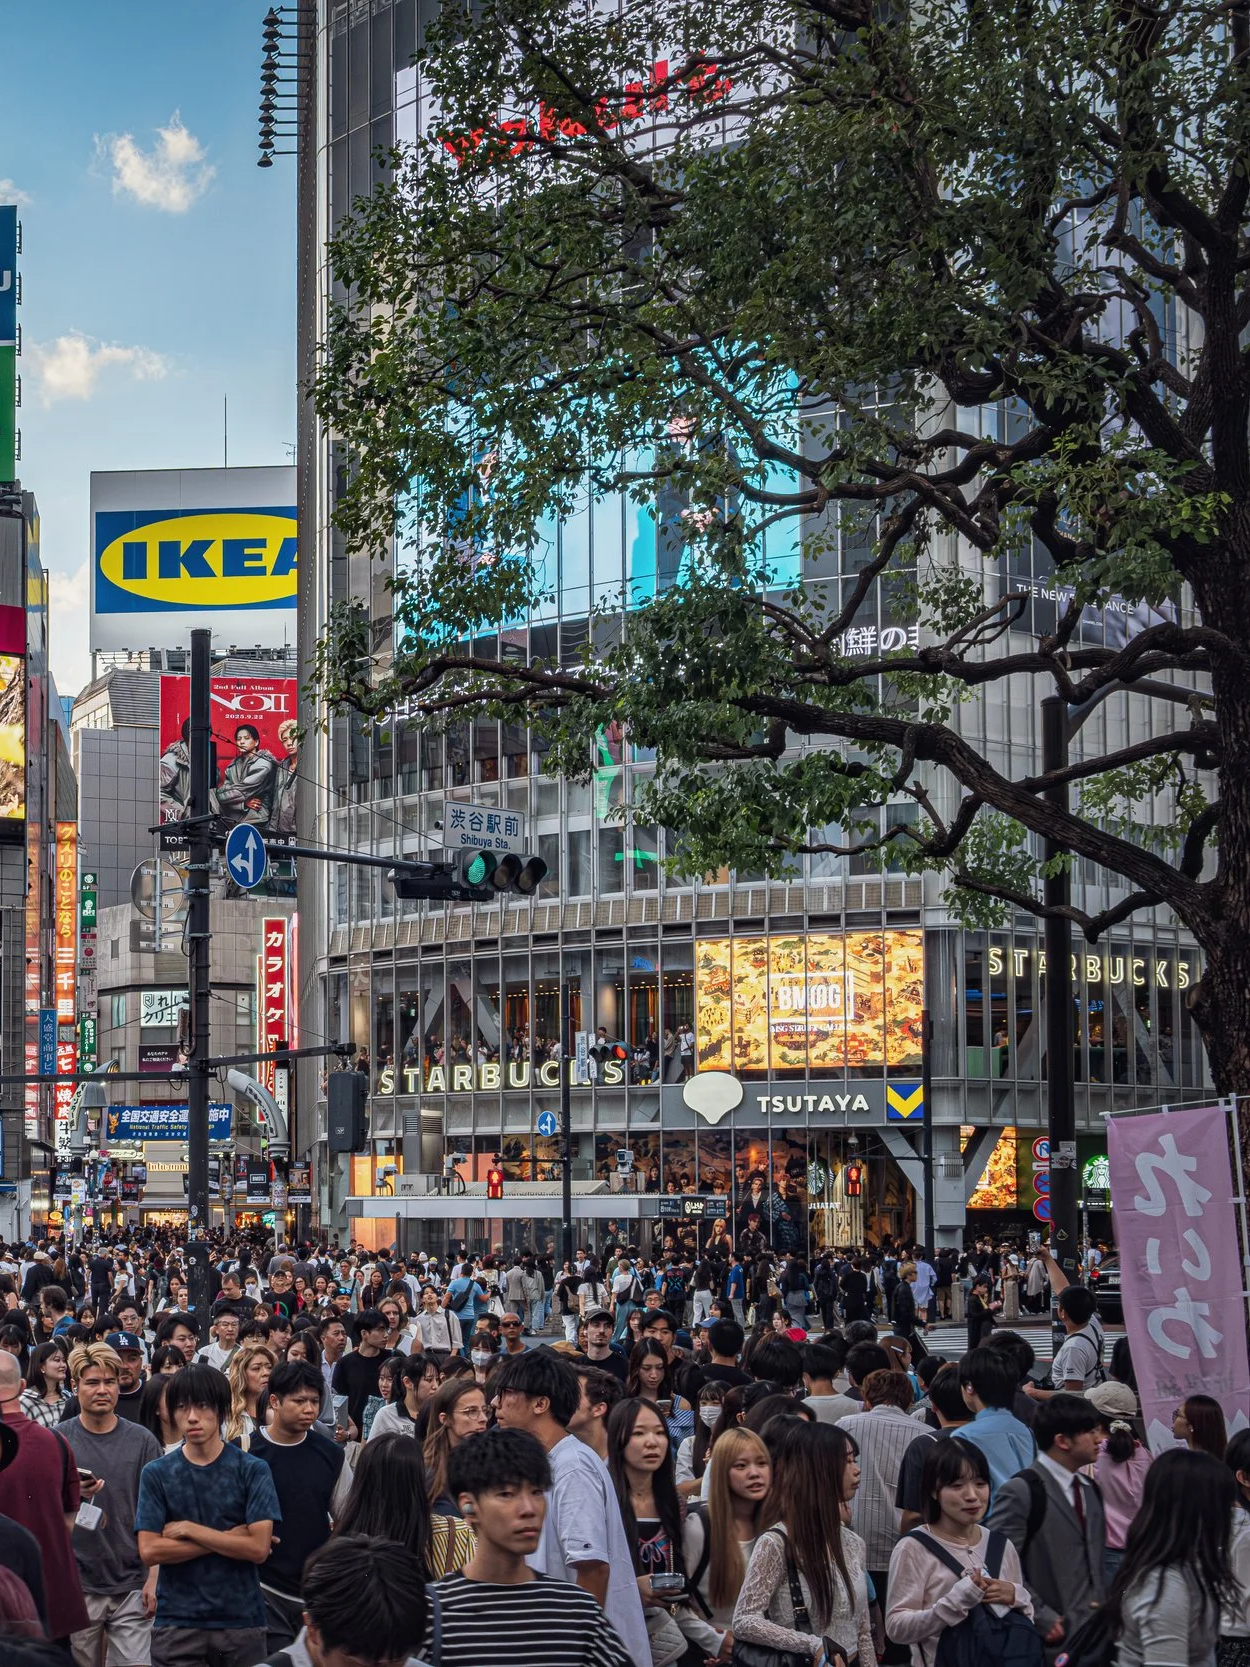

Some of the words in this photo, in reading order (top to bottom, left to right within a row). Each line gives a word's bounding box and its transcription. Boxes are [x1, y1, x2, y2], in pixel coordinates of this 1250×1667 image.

[1016, 583, 1039, 597] THE
[1041, 588, 1067, 602] NEW
[450, 808, 519, 838] 渋谷駅前
[460, 833, 492, 849] Shibuya
[494, 837, 511, 850] Sta.
[58, 826, 74, 938] クスリのことなら
[265, 931, 284, 1024] カラオケ
[381, 1060, 623, 1095] STARBUCS
[756, 1094, 869, 1113] TSUTAYA
[120, 1109, 230, 1123] 全国交通安全運施中
